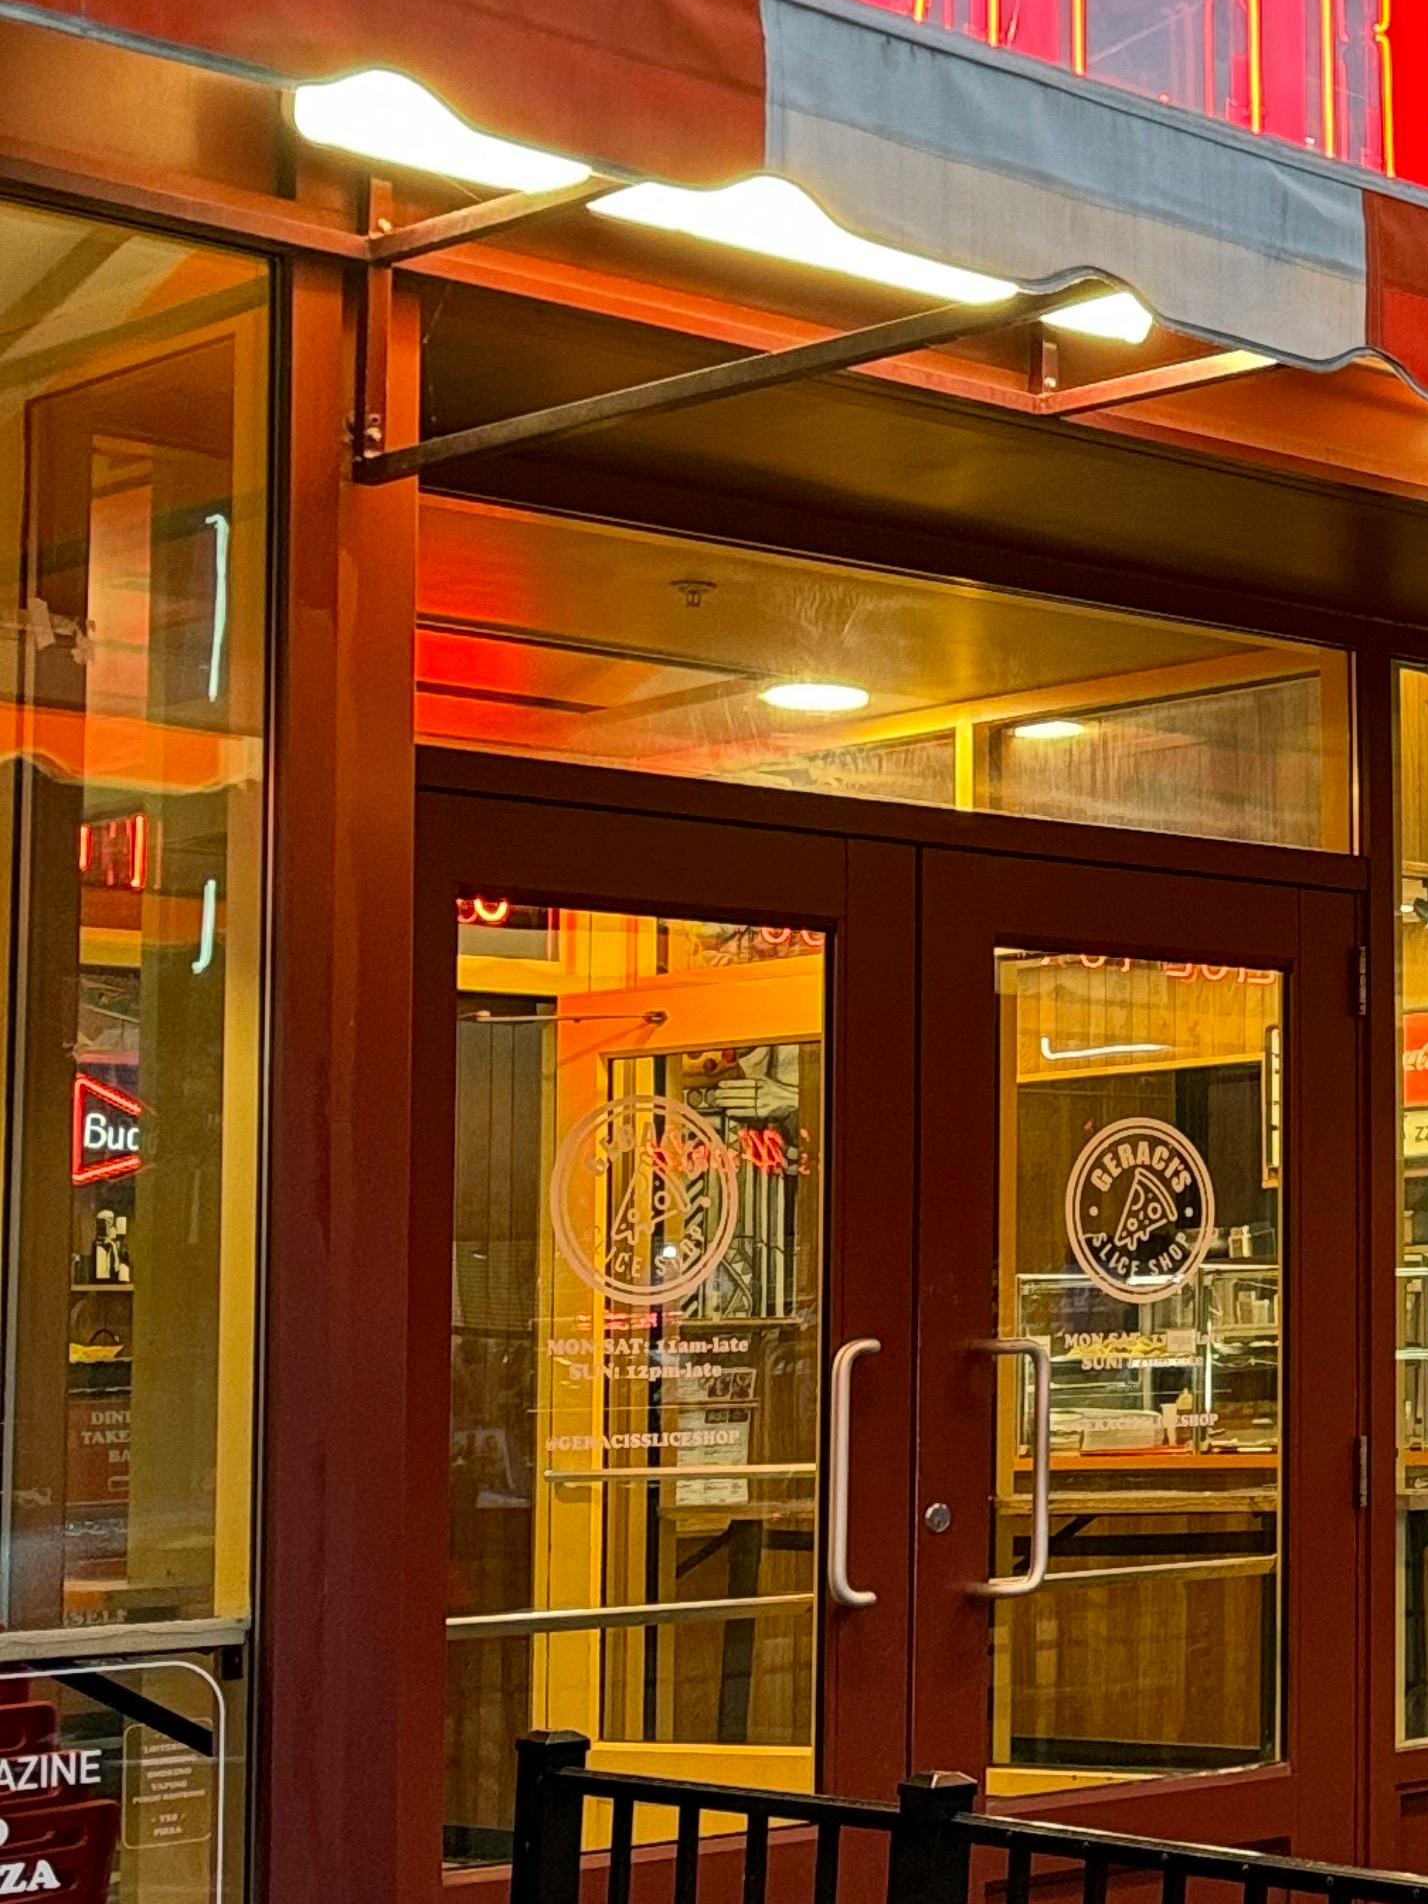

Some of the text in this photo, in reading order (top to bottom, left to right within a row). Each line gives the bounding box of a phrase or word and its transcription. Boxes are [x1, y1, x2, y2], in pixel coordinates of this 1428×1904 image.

[1090, 1141, 1193, 1193] GERACI'S
[1150, 1231, 1191, 1278] SHOP
[546, 1338, 650, 1356] MONSAT:
